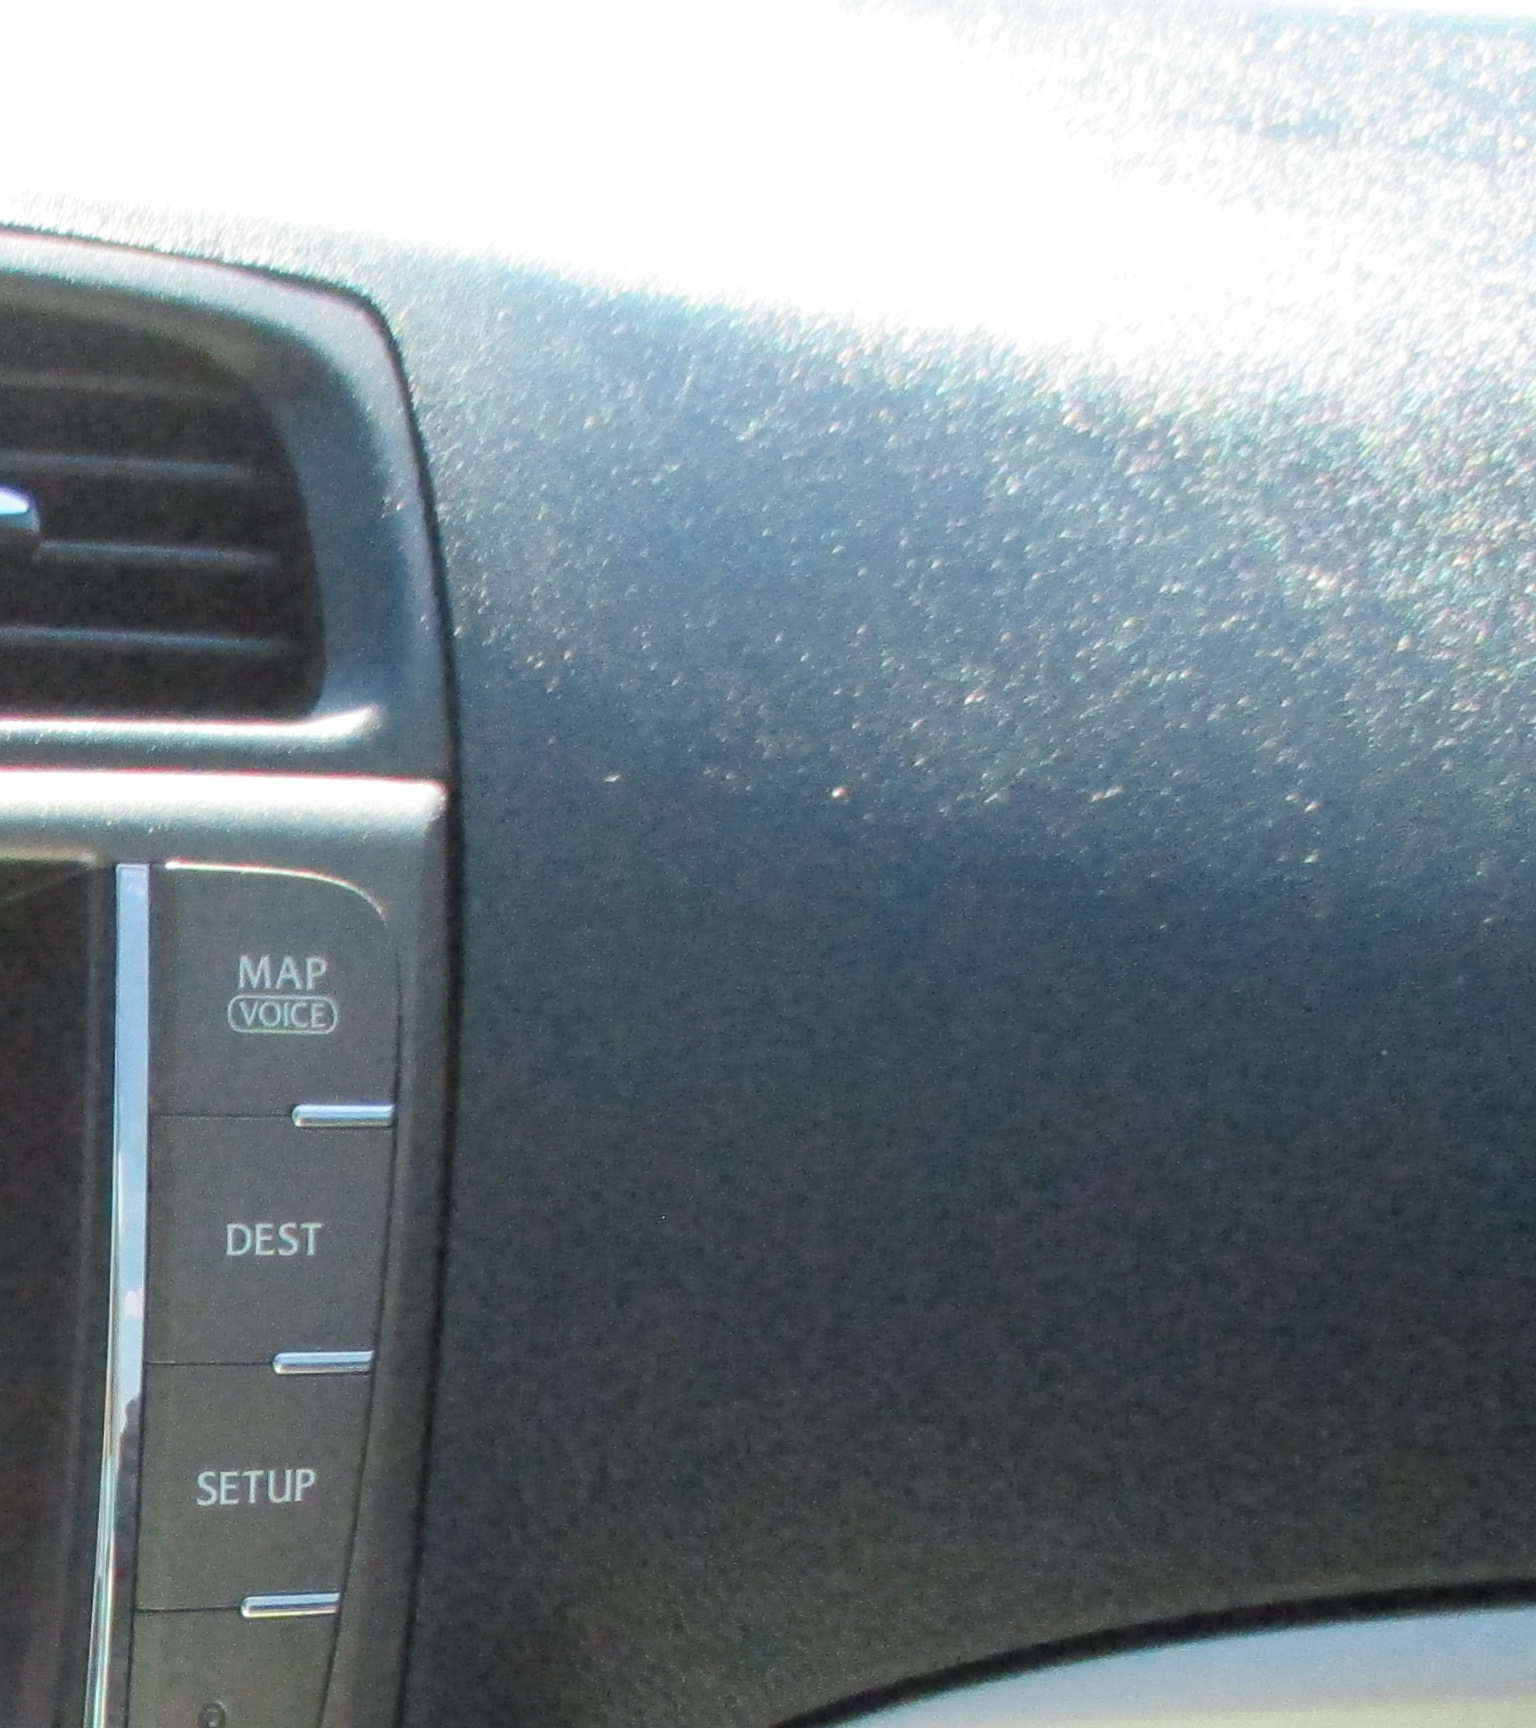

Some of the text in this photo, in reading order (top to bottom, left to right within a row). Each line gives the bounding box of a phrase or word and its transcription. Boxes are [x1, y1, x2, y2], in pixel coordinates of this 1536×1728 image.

[239, 956, 328, 991] MAP
[239, 1000, 327, 1031] VOICE
[225, 1223, 323, 1259] DEST
[196, 1467, 318, 1508] SETUP
